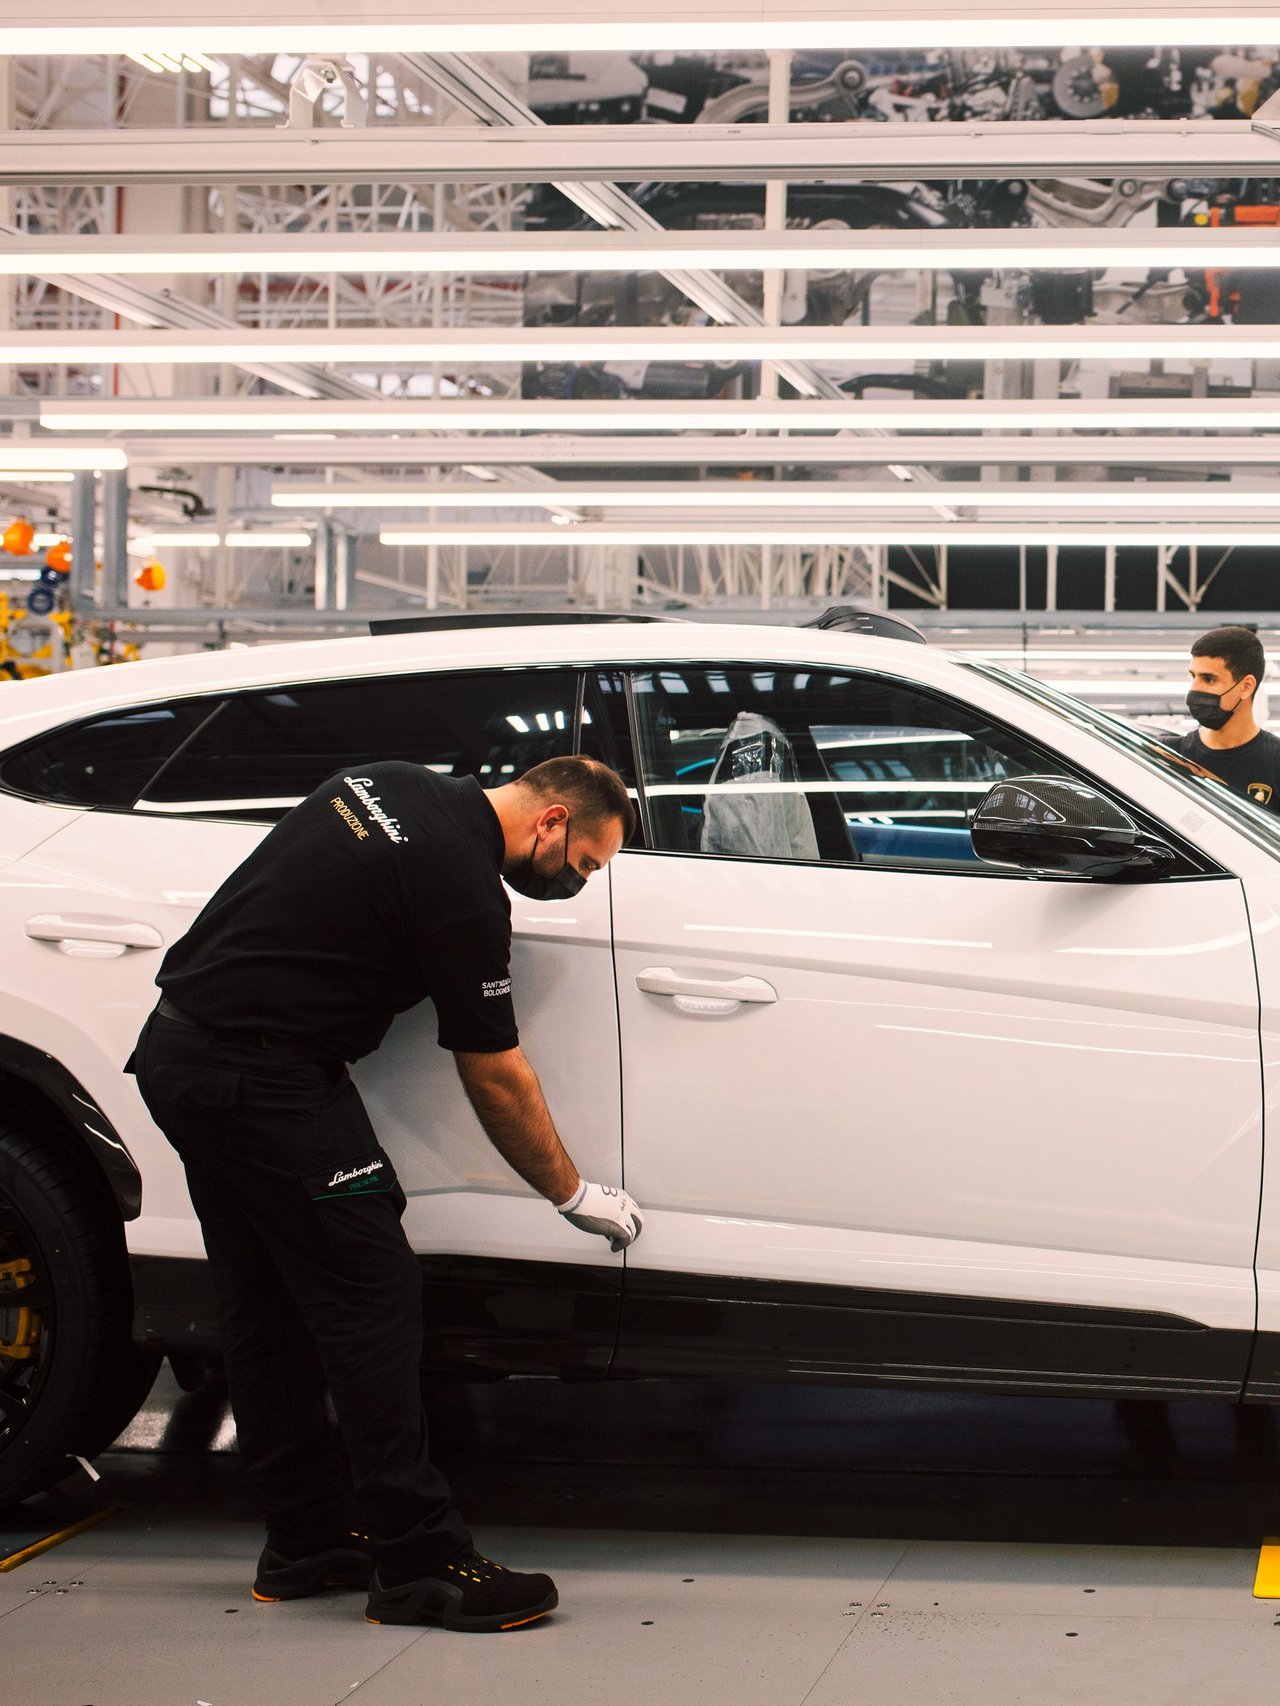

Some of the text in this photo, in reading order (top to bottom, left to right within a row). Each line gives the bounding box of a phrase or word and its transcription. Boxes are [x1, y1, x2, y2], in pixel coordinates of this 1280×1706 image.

[330, 796, 370, 841] PRODUZIONE
[343, 776, 409, 844] Lamborghini
[328, 1159, 383, 1187] Lamborghini
